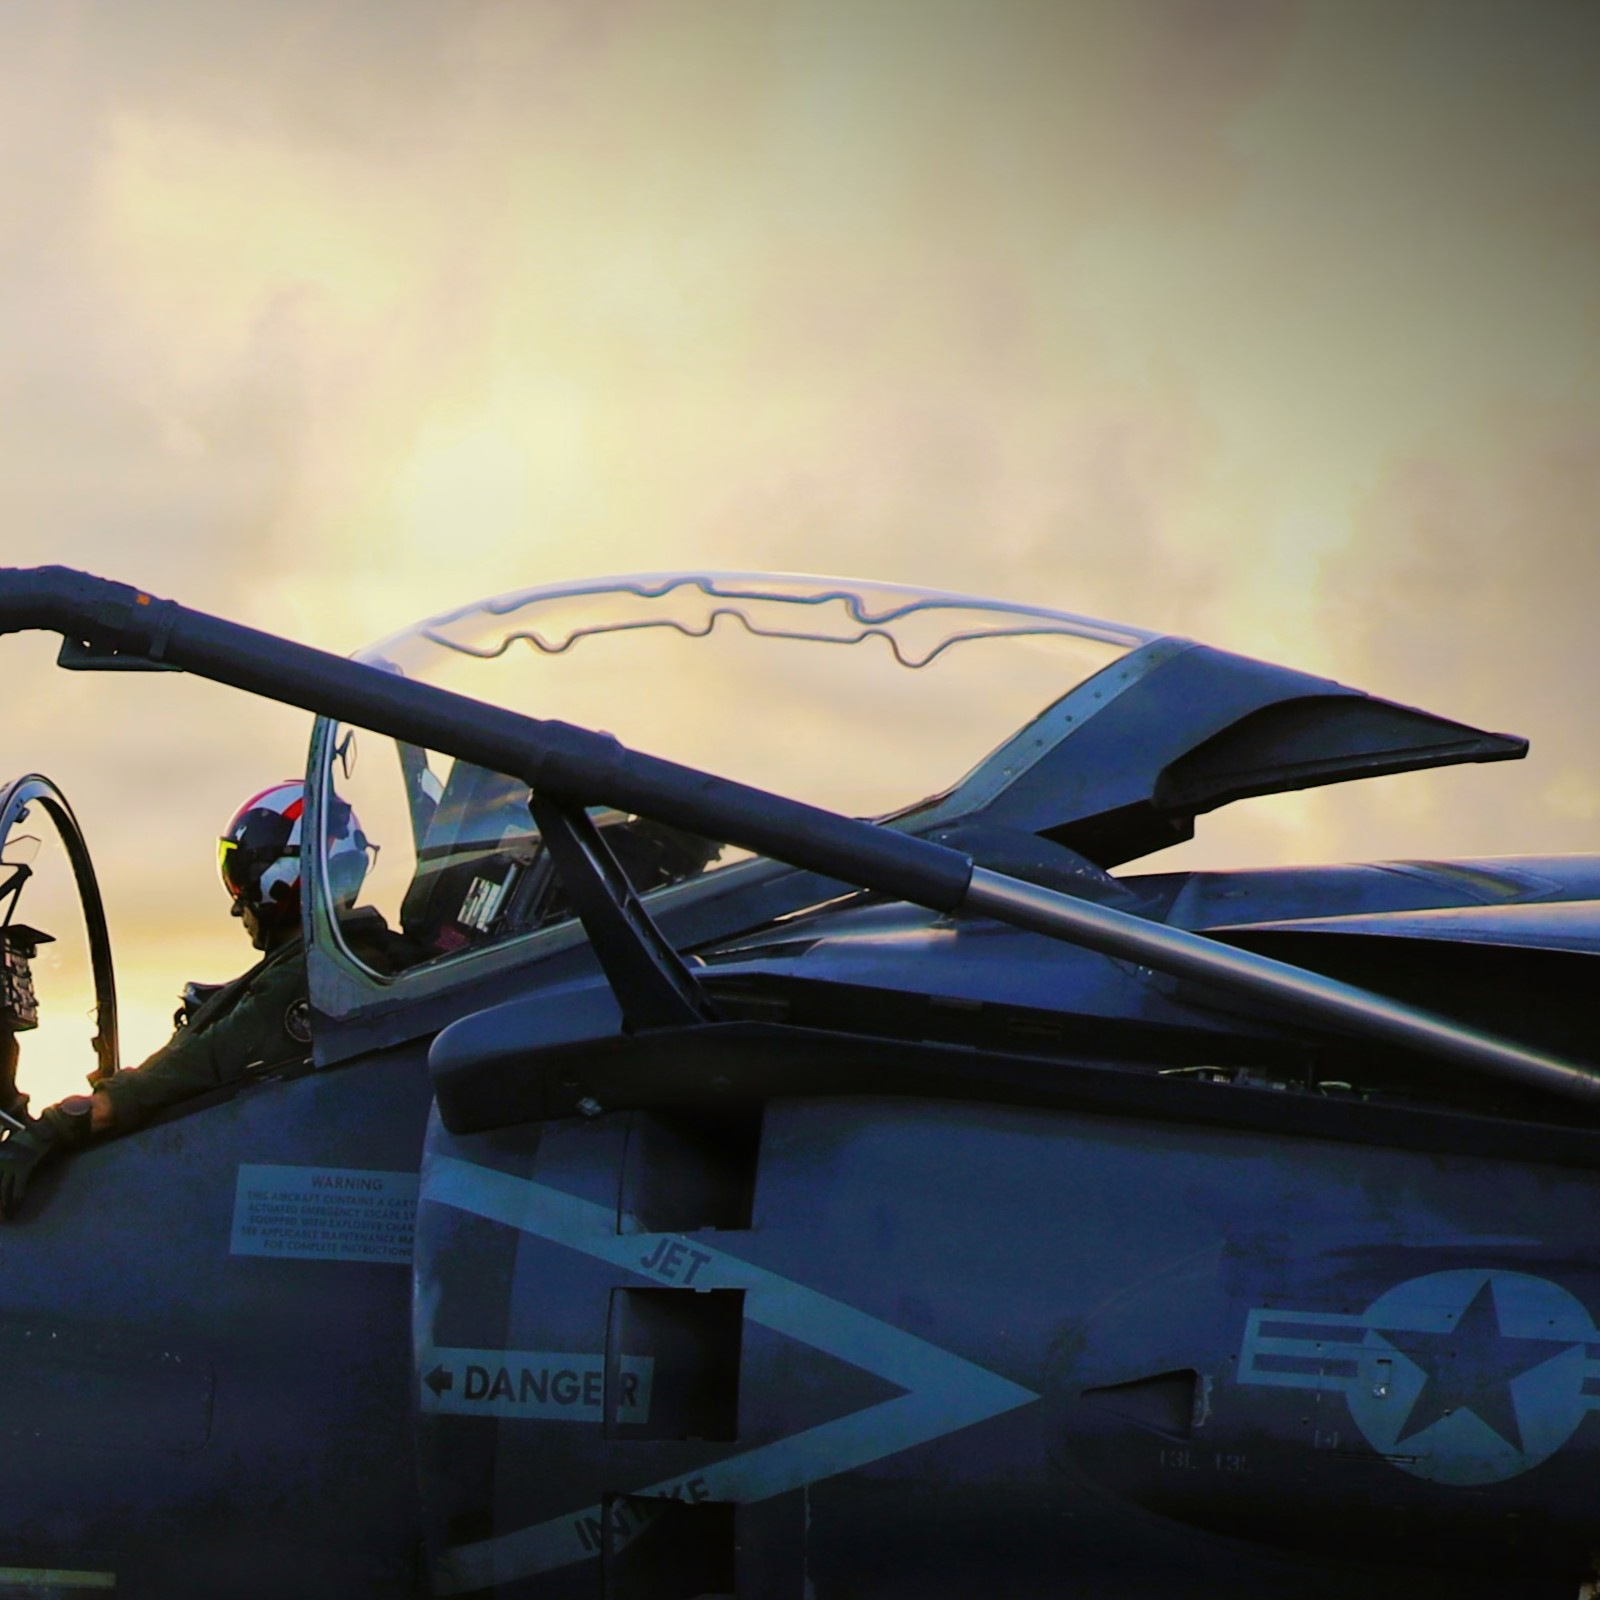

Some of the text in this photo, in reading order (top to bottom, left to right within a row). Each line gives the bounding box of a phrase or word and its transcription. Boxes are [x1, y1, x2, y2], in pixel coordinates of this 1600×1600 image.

[311, 1175, 384, 1191] WARNING
[639, 1237, 713, 1285] JET
[463, 1363, 640, 1408] DANGER
